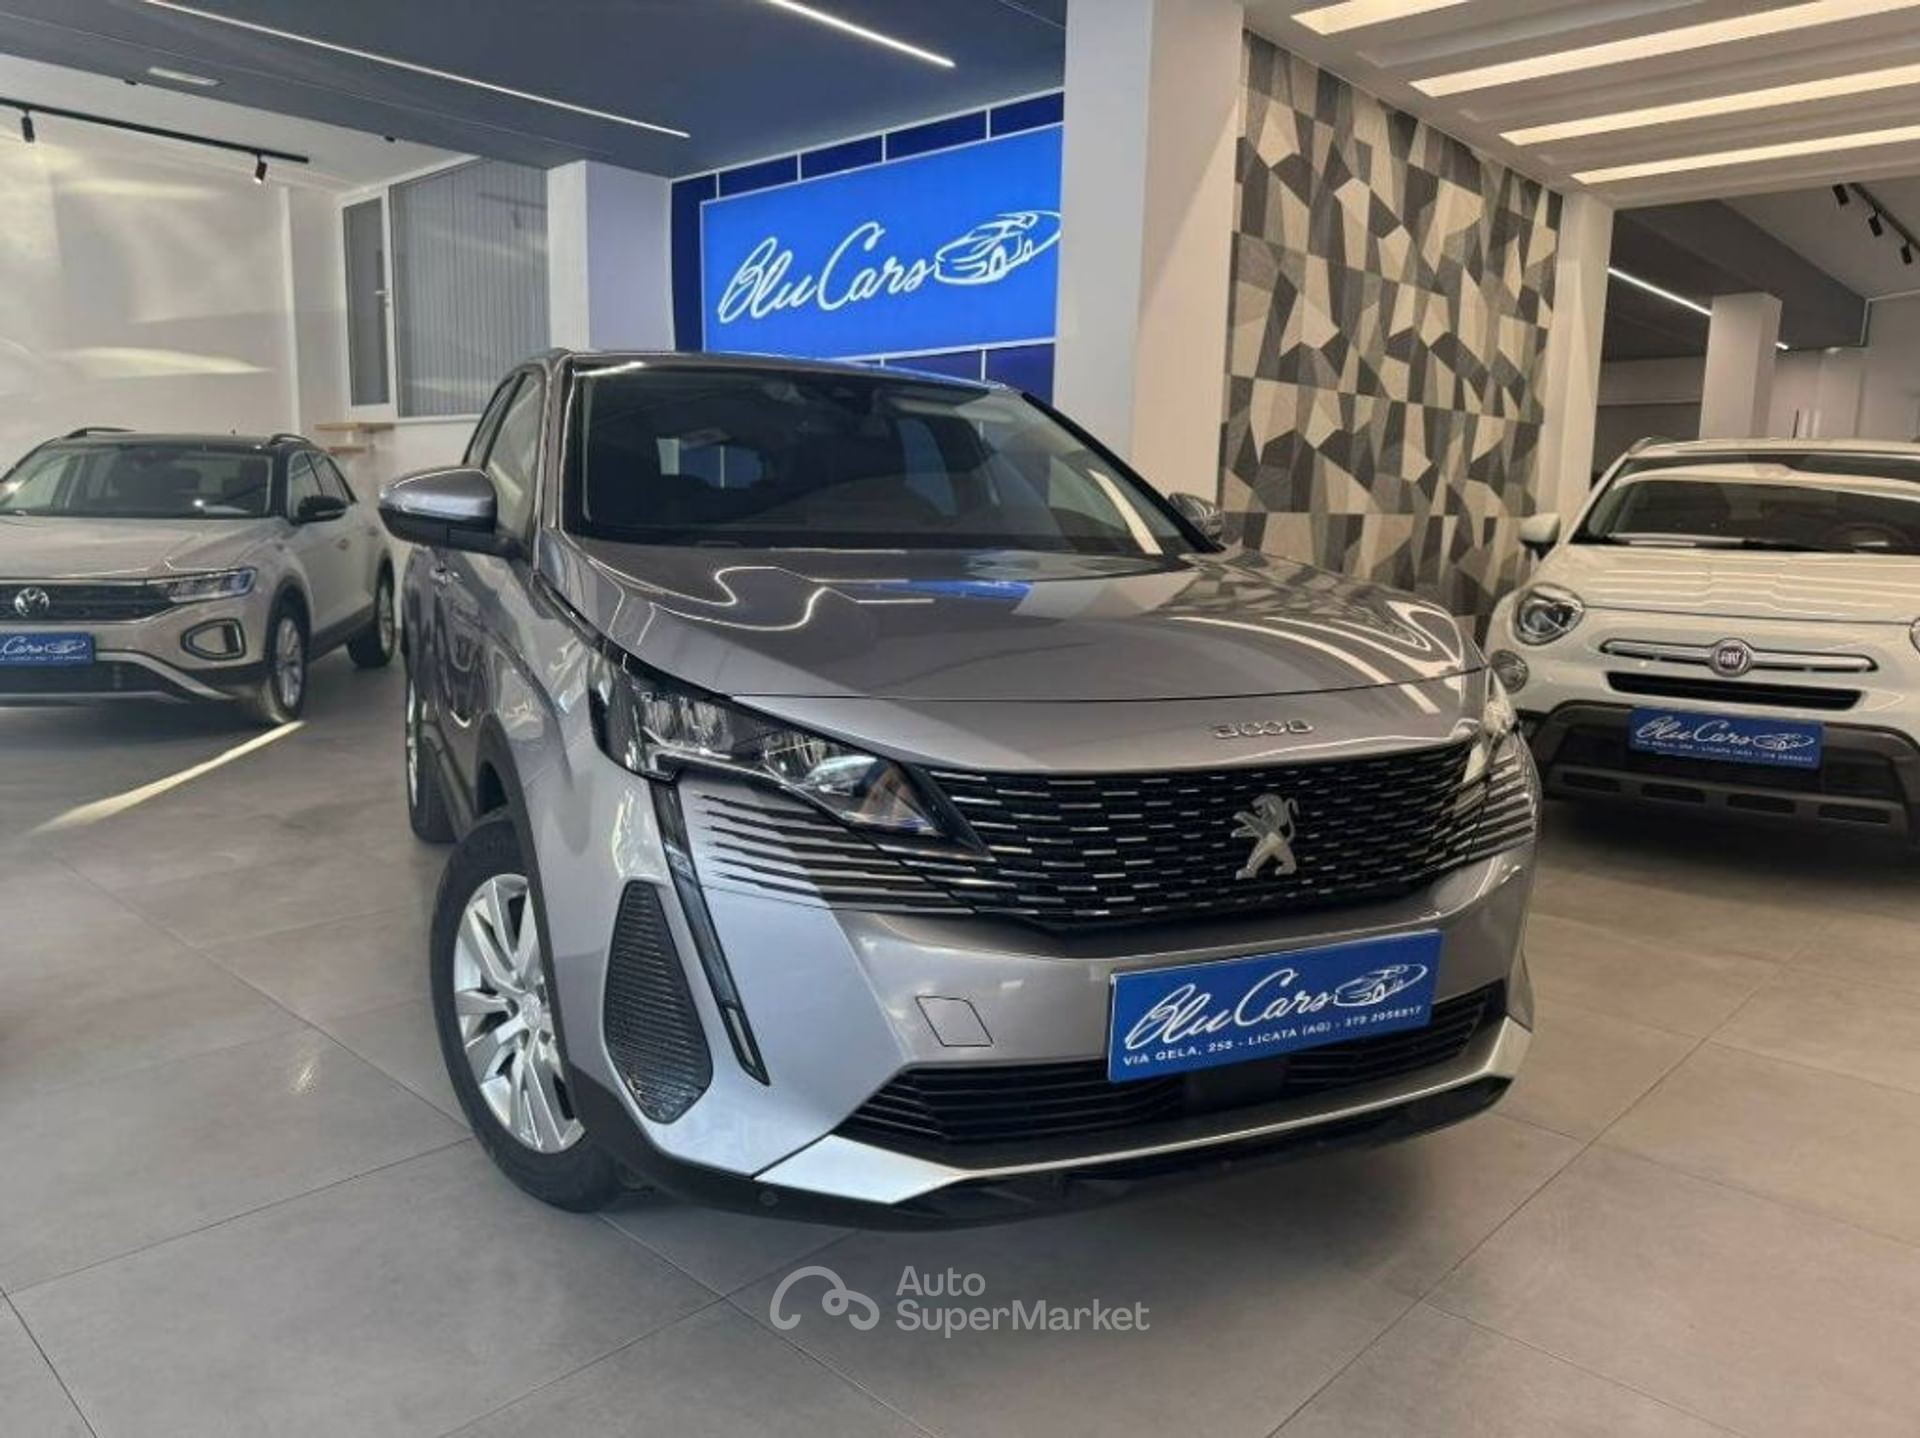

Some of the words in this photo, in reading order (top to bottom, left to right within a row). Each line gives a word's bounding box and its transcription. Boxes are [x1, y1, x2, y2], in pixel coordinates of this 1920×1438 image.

[718, 236, 819, 324] Blu
[816, 221, 937, 311] Cars
[1214, 719, 1313, 739] 3008
[1636, 715, 1695, 741] Blu
[1693, 719, 1753, 745] Cars
[1124, 983, 1237, 1050] Blu
[1234, 968, 1337, 1026] Cars
[1123, 1053, 1149, 1066] VIA
[1248, 1027, 1298, 1046] LICATA
[1302, 1021, 1332, 1036] (AG)
